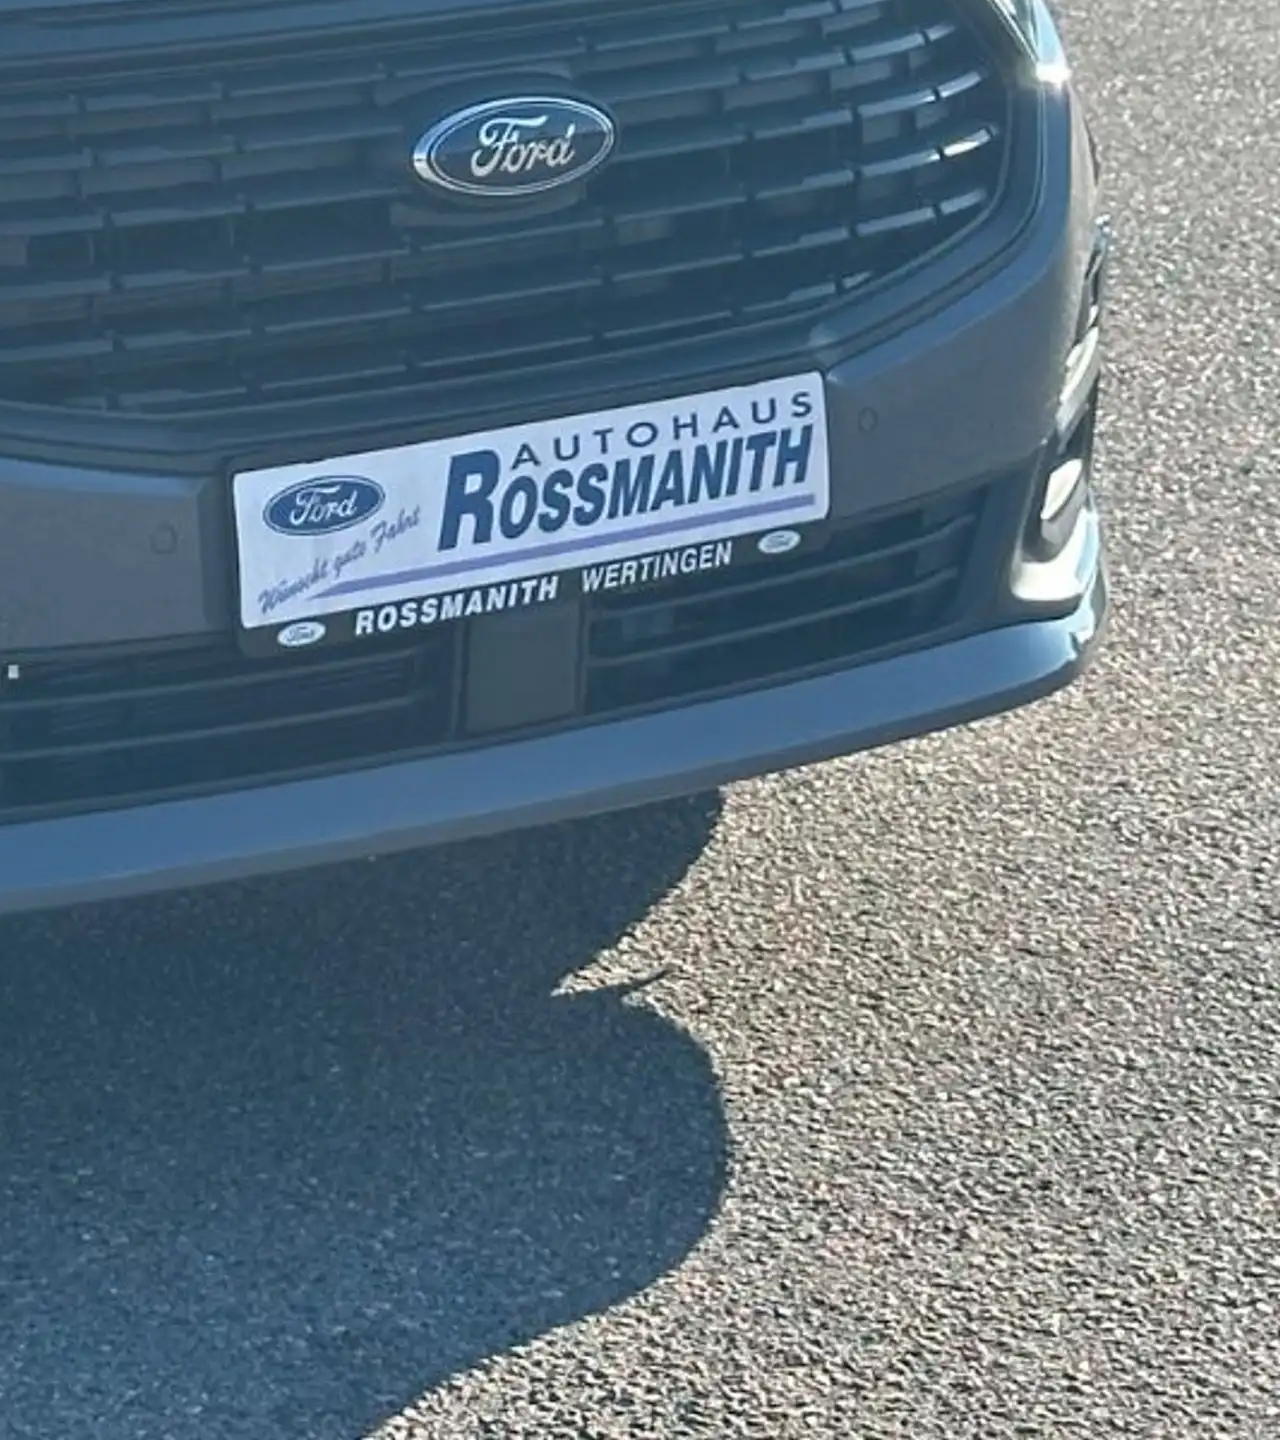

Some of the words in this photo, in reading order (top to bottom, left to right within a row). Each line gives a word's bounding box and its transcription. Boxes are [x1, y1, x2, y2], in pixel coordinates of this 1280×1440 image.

[470, 115, 576, 177] Ford
[510, 391, 813, 470] AUTOHAUS
[290, 483, 358, 525] Ford
[437, 424, 814, 552] ROSSMANITH
[370, 505, 421, 553] Fahrt
[354, 575, 559, 636] ROSSMANITH
[581, 540, 733, 593] WERTINGEN
